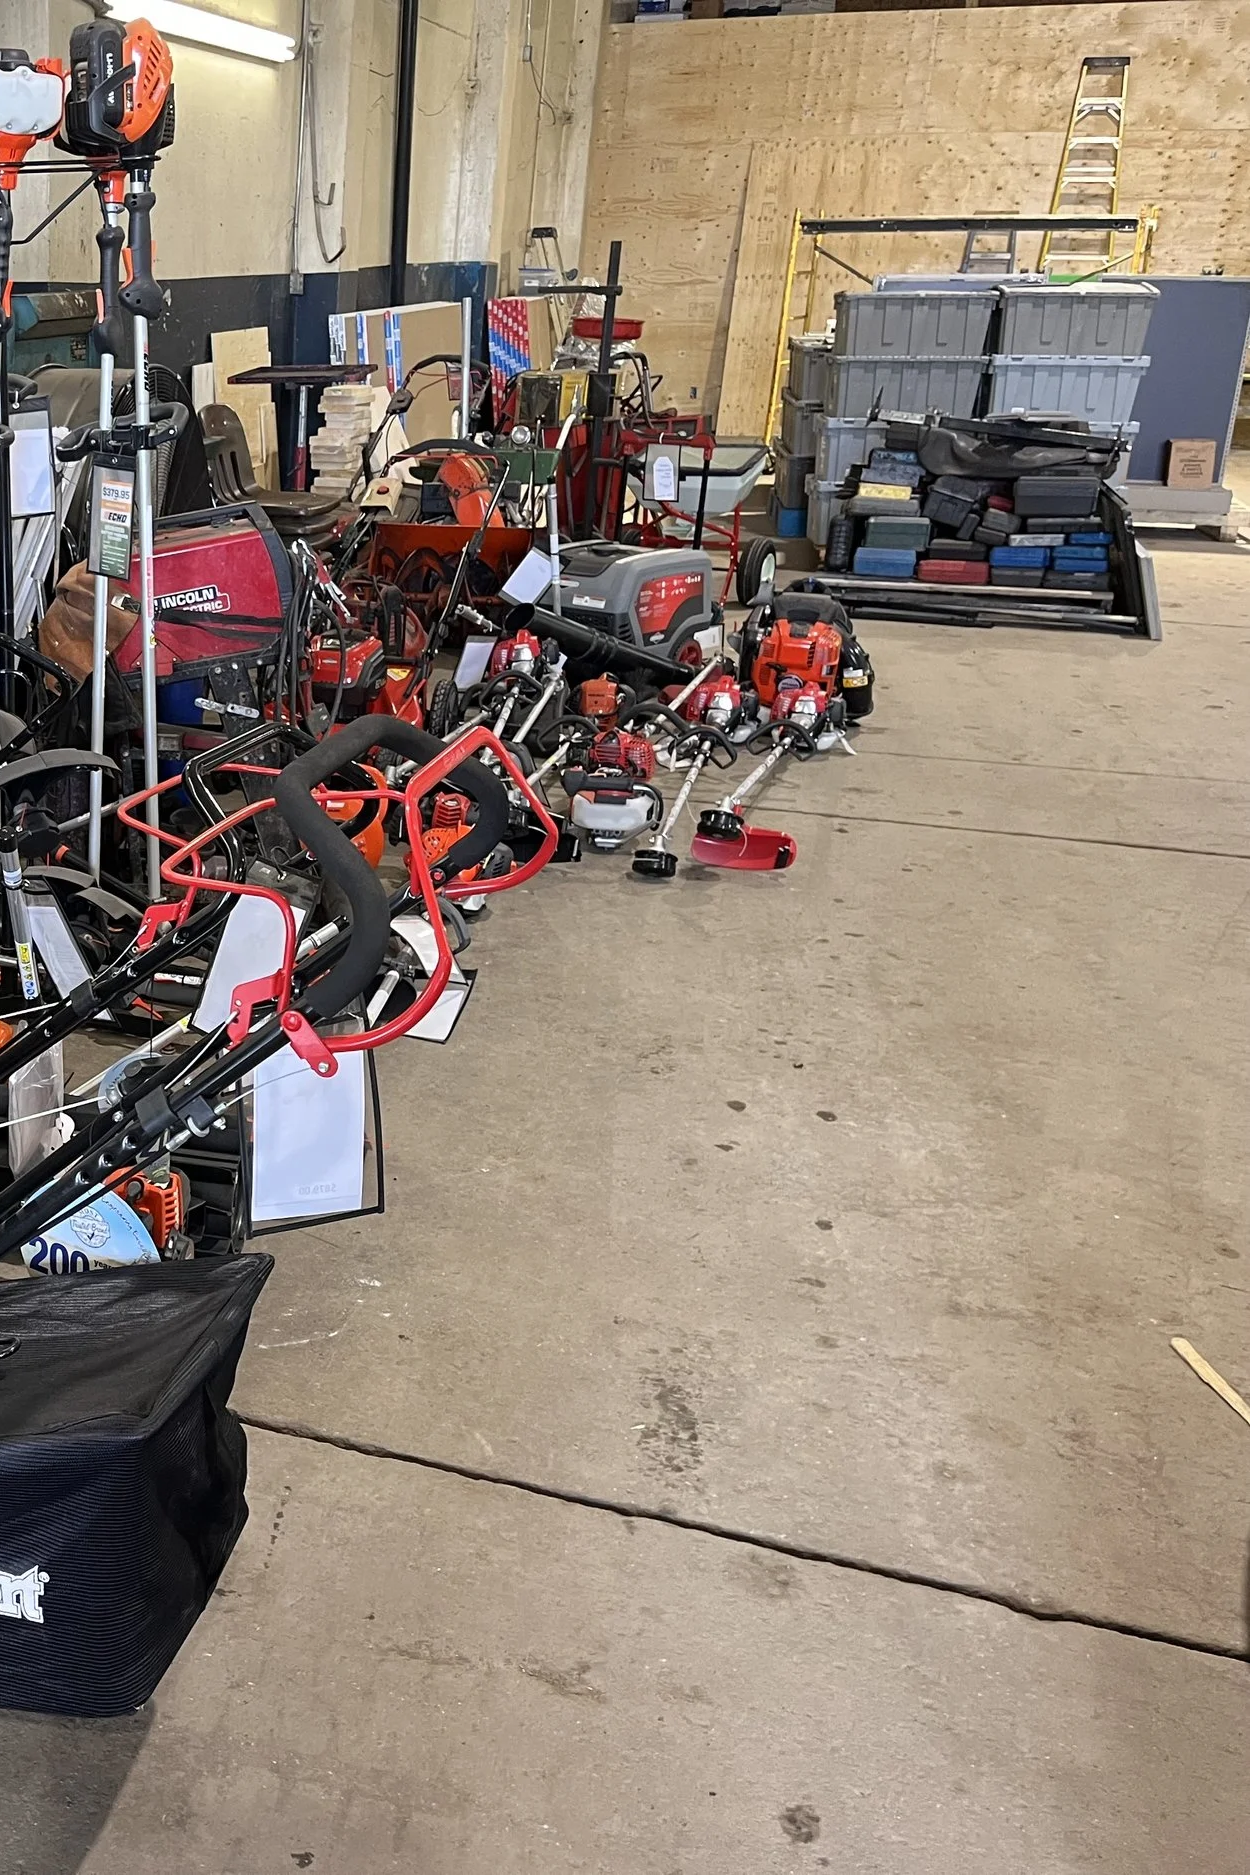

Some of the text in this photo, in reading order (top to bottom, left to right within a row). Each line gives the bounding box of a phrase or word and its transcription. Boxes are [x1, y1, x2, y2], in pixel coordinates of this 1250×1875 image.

[102, 486, 130, 500] $379.95
[108, 512, 127, 523] ECHO
[154, 588, 214, 610] INCOLN
[29, 1237, 90, 1276] 200
